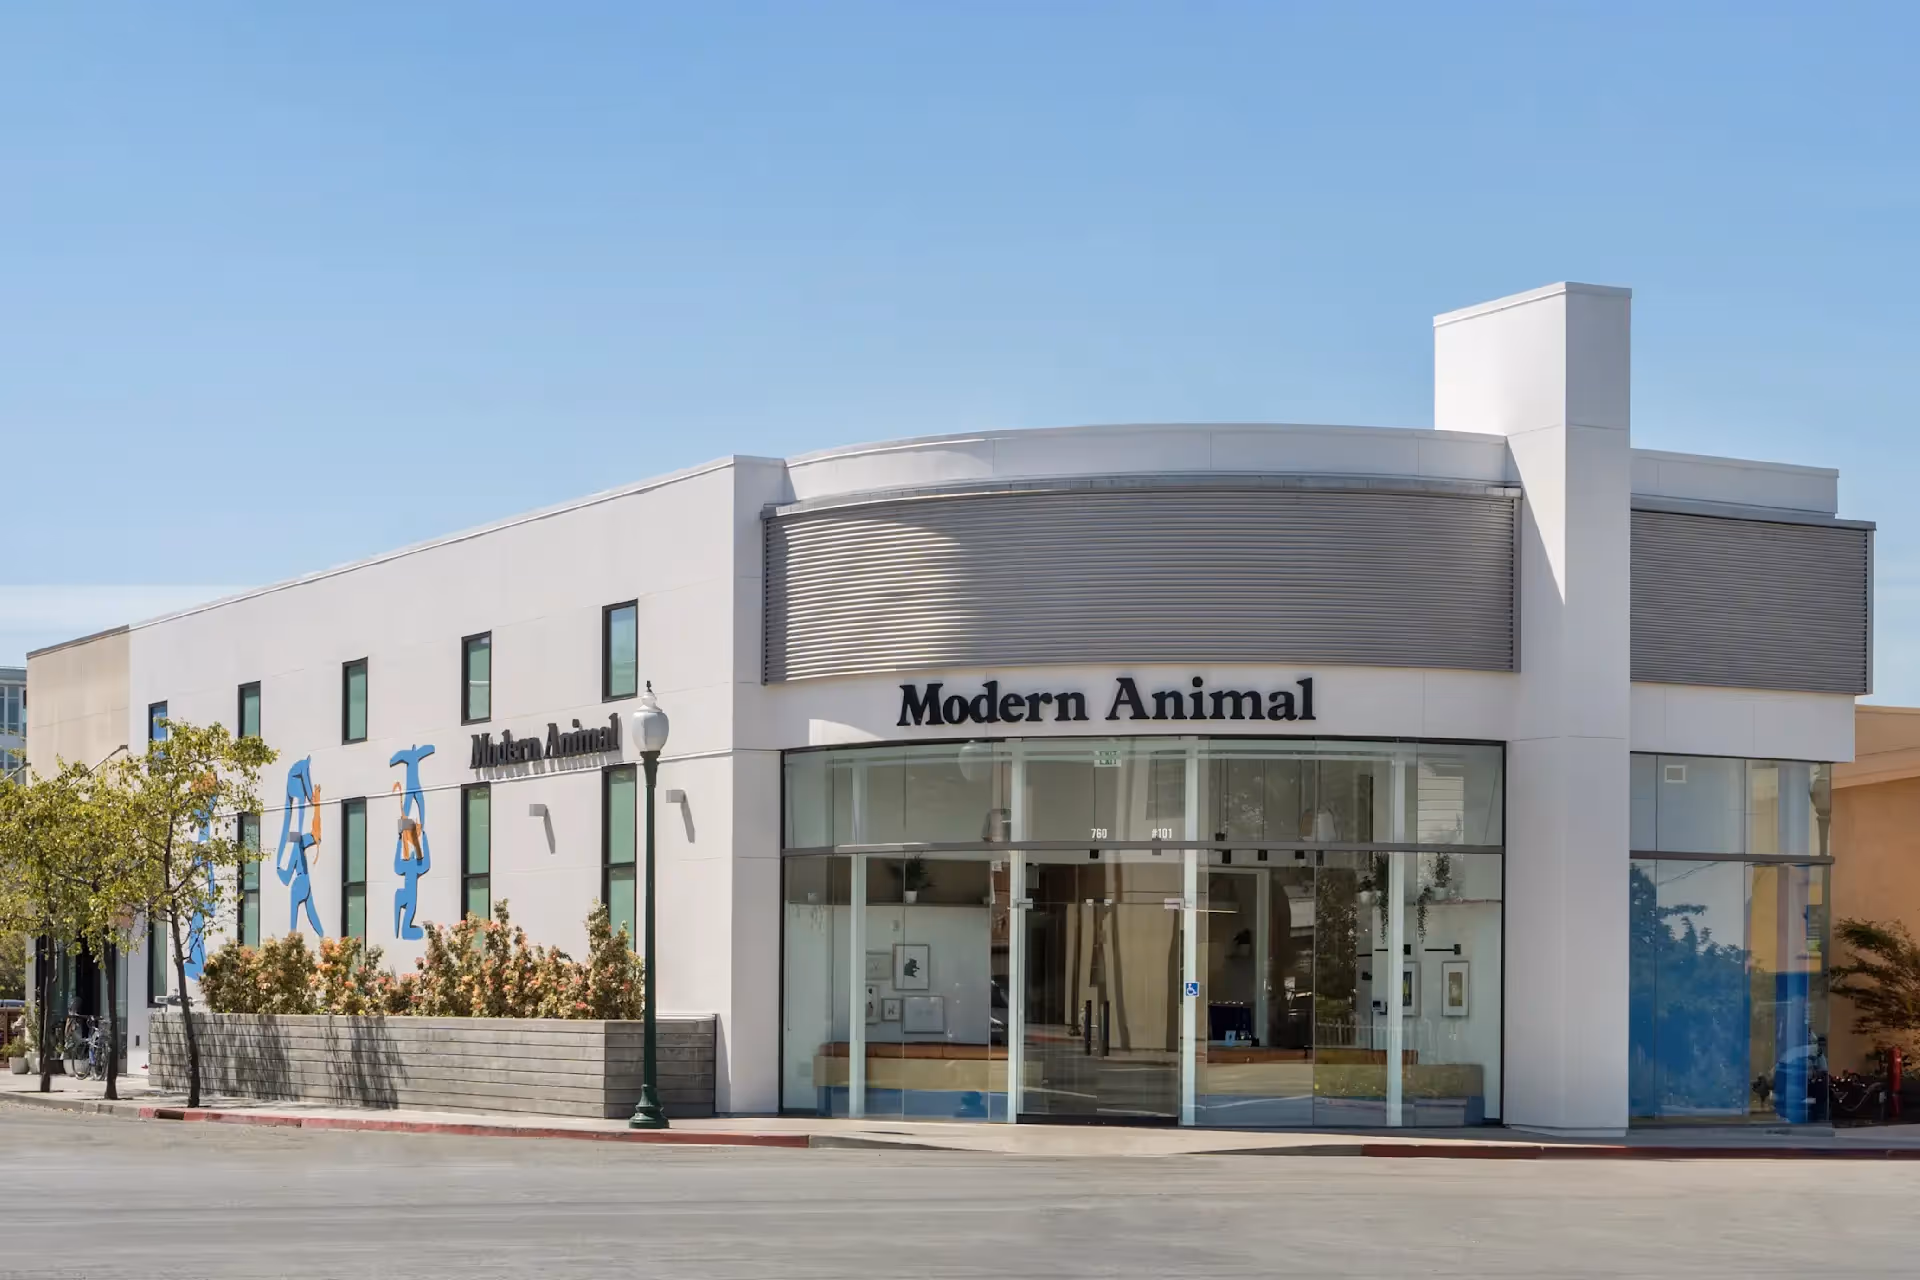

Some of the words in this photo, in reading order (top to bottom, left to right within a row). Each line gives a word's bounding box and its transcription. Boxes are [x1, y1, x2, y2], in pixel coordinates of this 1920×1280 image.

[897, 681, 1090, 727] Modern
[1104, 676, 1317, 721] Animal
[470, 729, 542, 769] Modern
[544, 712, 620, 759] Animal
[1090, 828, 1108, 839] 760
[1151, 828, 1172, 839] #101
